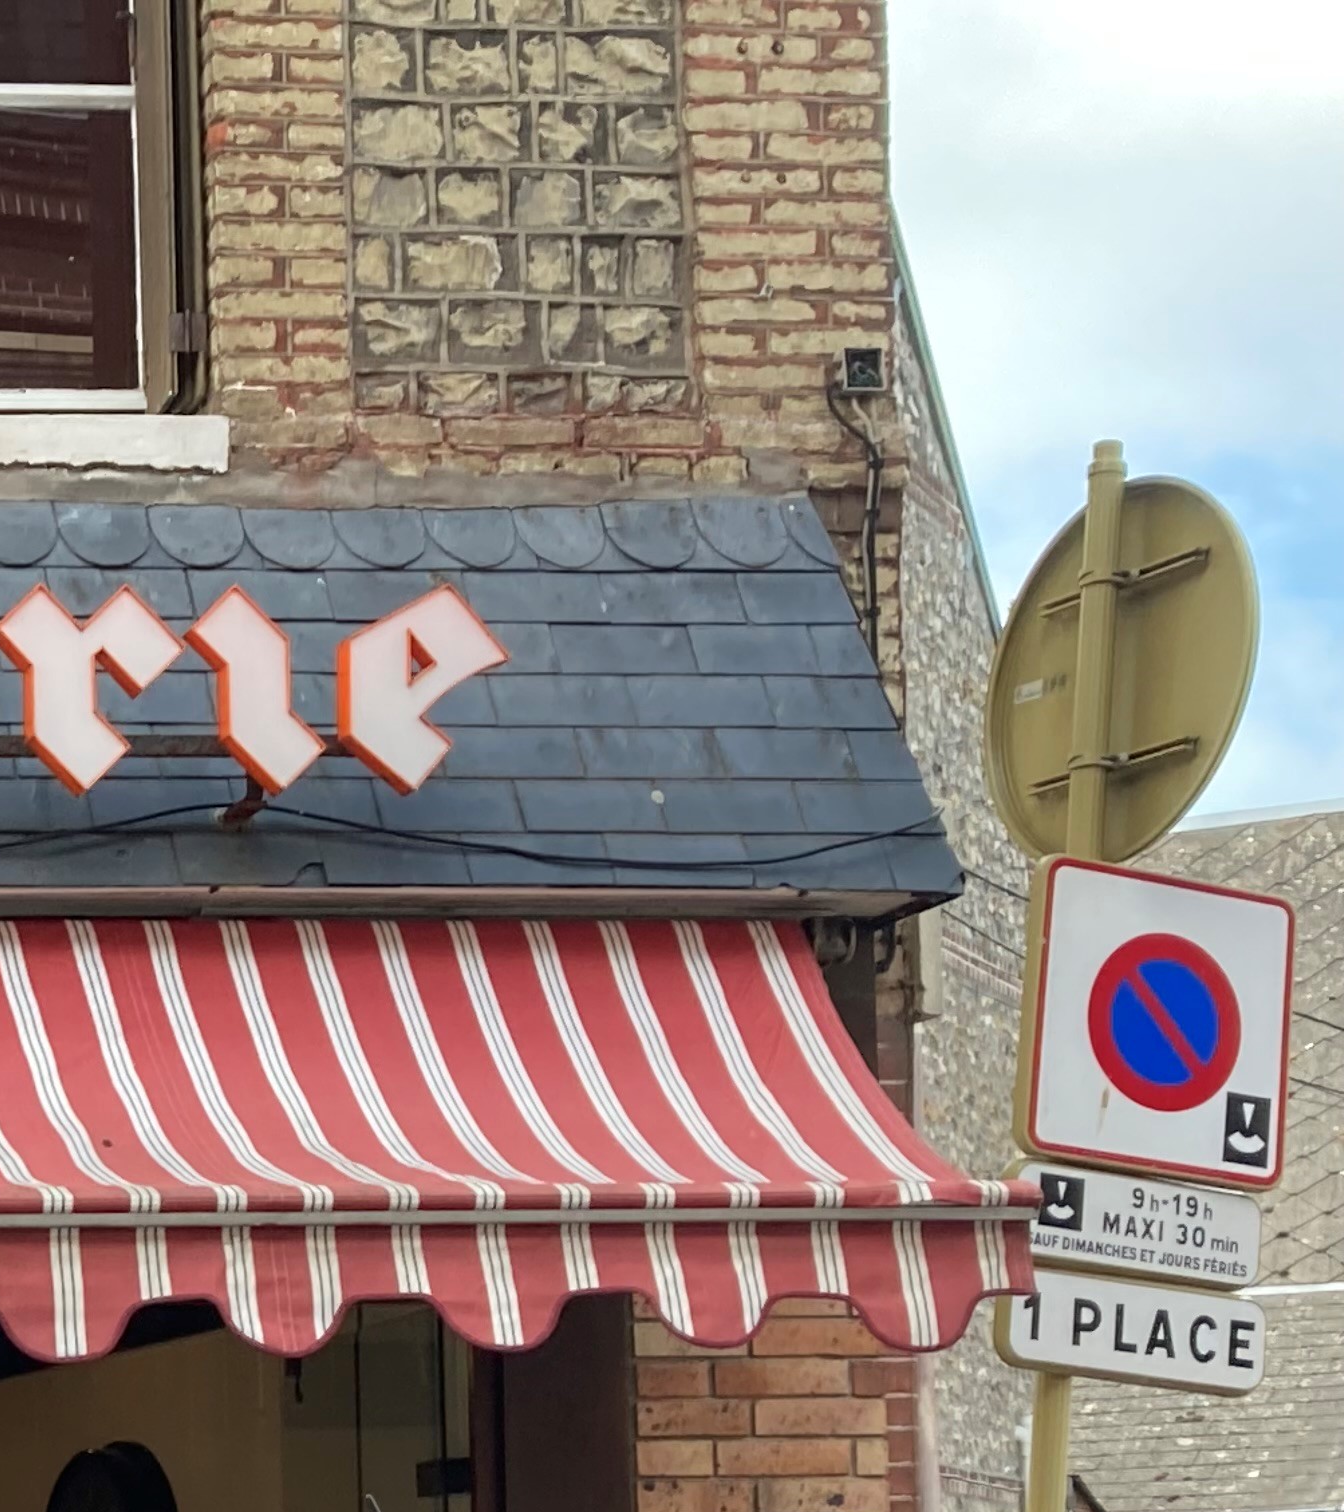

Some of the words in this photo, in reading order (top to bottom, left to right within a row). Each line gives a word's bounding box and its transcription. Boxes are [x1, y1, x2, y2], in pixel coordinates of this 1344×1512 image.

[1102, 1212, 1164, 1242] MAXI
[1175, 1223, 1206, 1248] 30
[1211, 1236, 1239, 1254] min
[1061, 1236, 1137, 1262] DIMANCHES
[1140, 1248, 1157, 1264] ET
[1159, 1251, 1200, 1271] JOURS
[1203, 1255, 1248, 1278] FÉRIÉS
[1023, 1291, 1042, 1341] 1
[1072, 1297, 1256, 1370] PLACE
